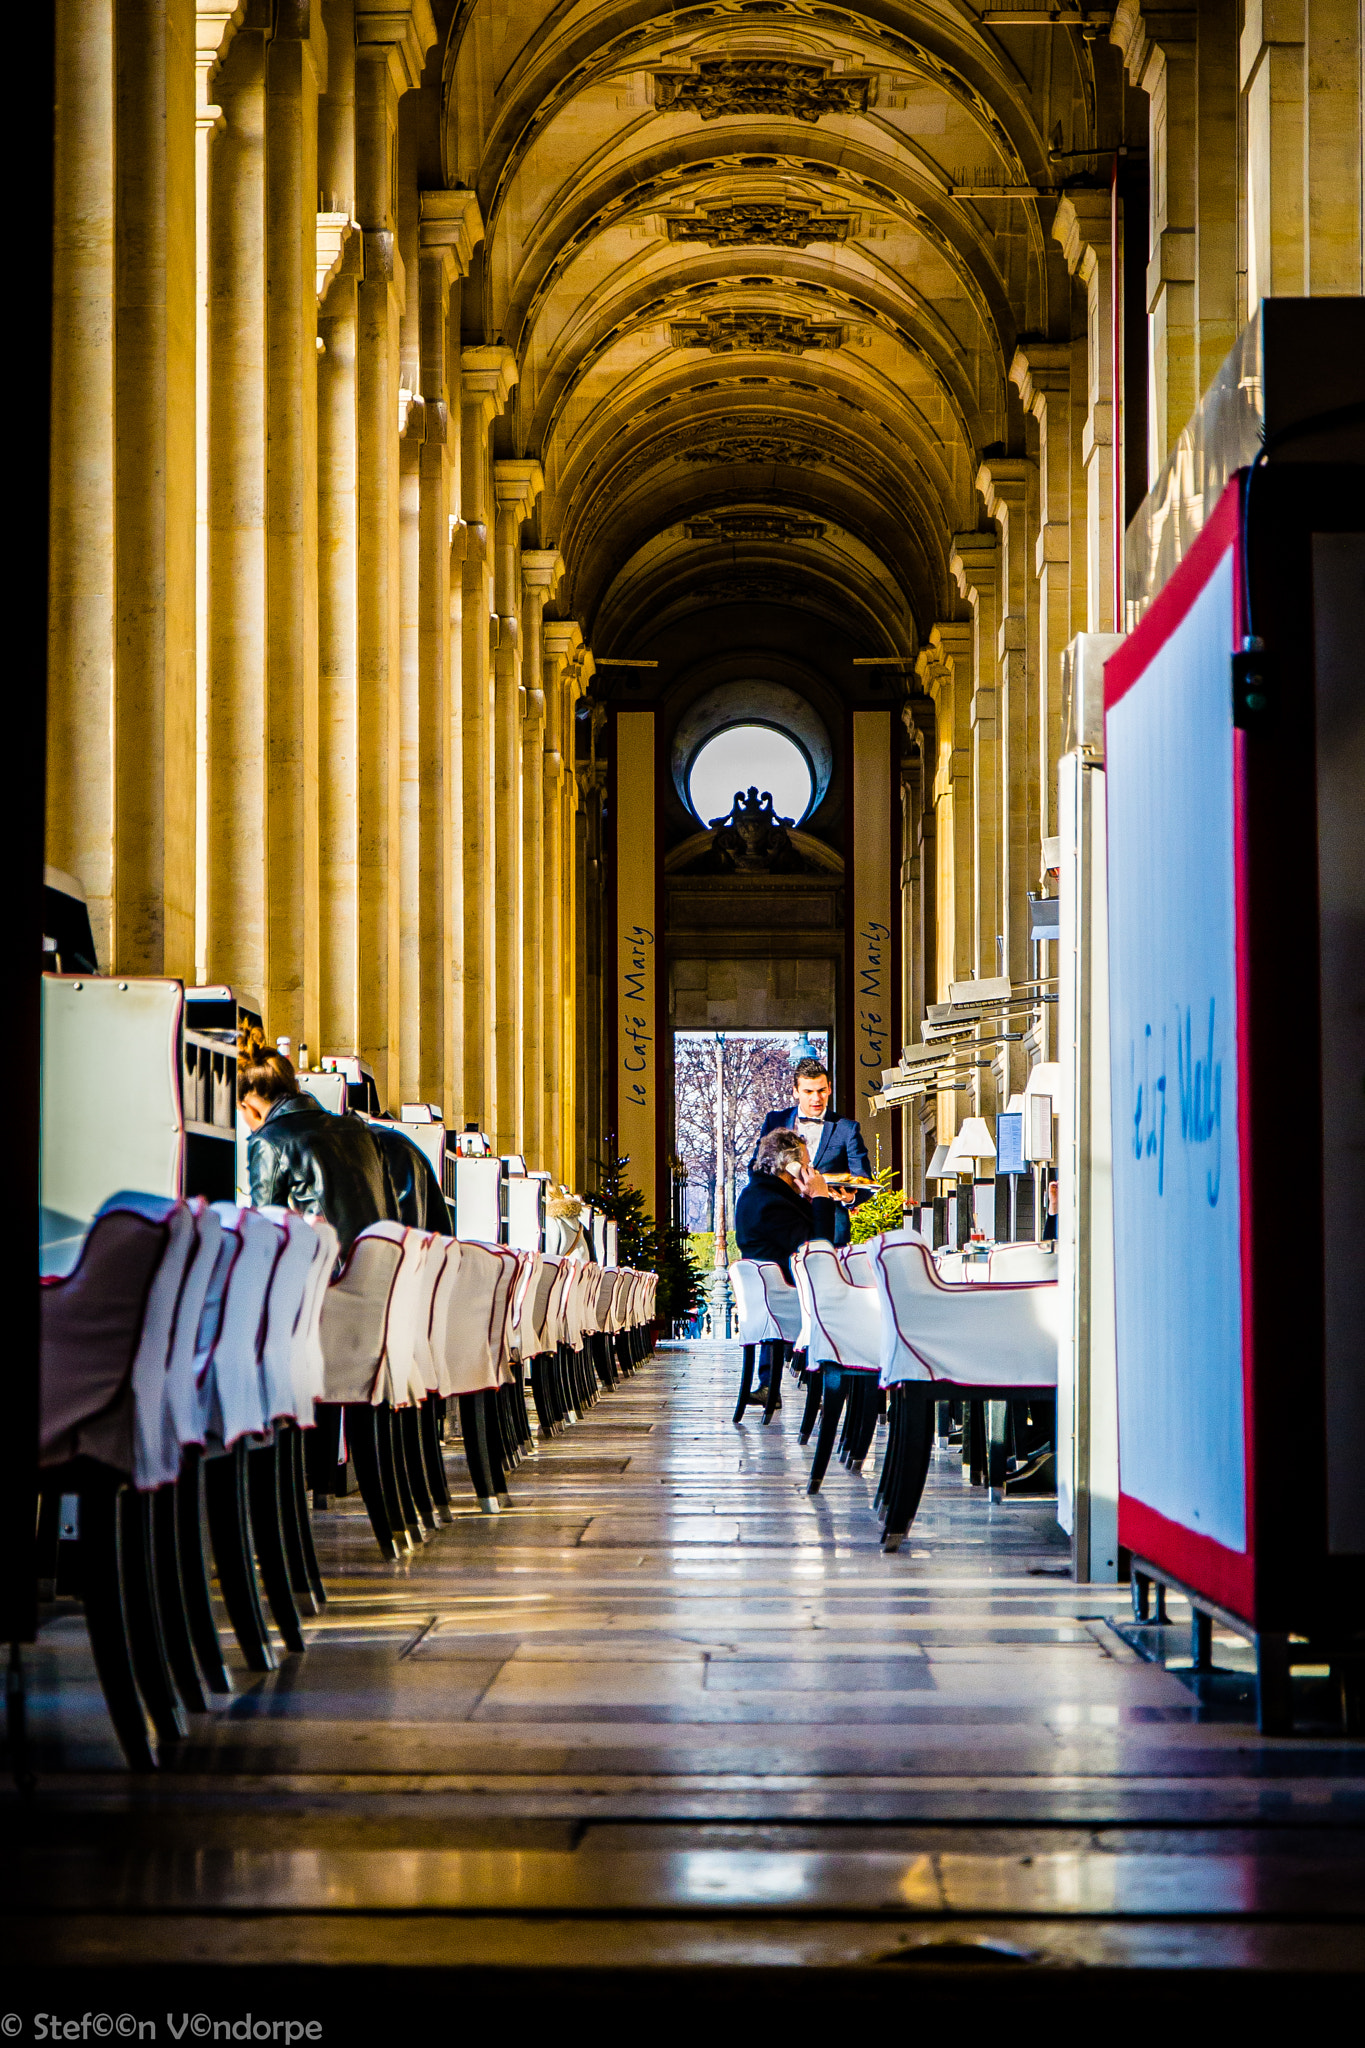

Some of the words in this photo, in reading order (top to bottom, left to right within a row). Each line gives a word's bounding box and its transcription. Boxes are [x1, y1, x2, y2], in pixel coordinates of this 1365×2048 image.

[624, 925, 654, 1001] Marly
[860, 921, 890, 997] Marly
[624, 1014, 653, 1072] Café
[859, 1011, 888, 1067] Café
